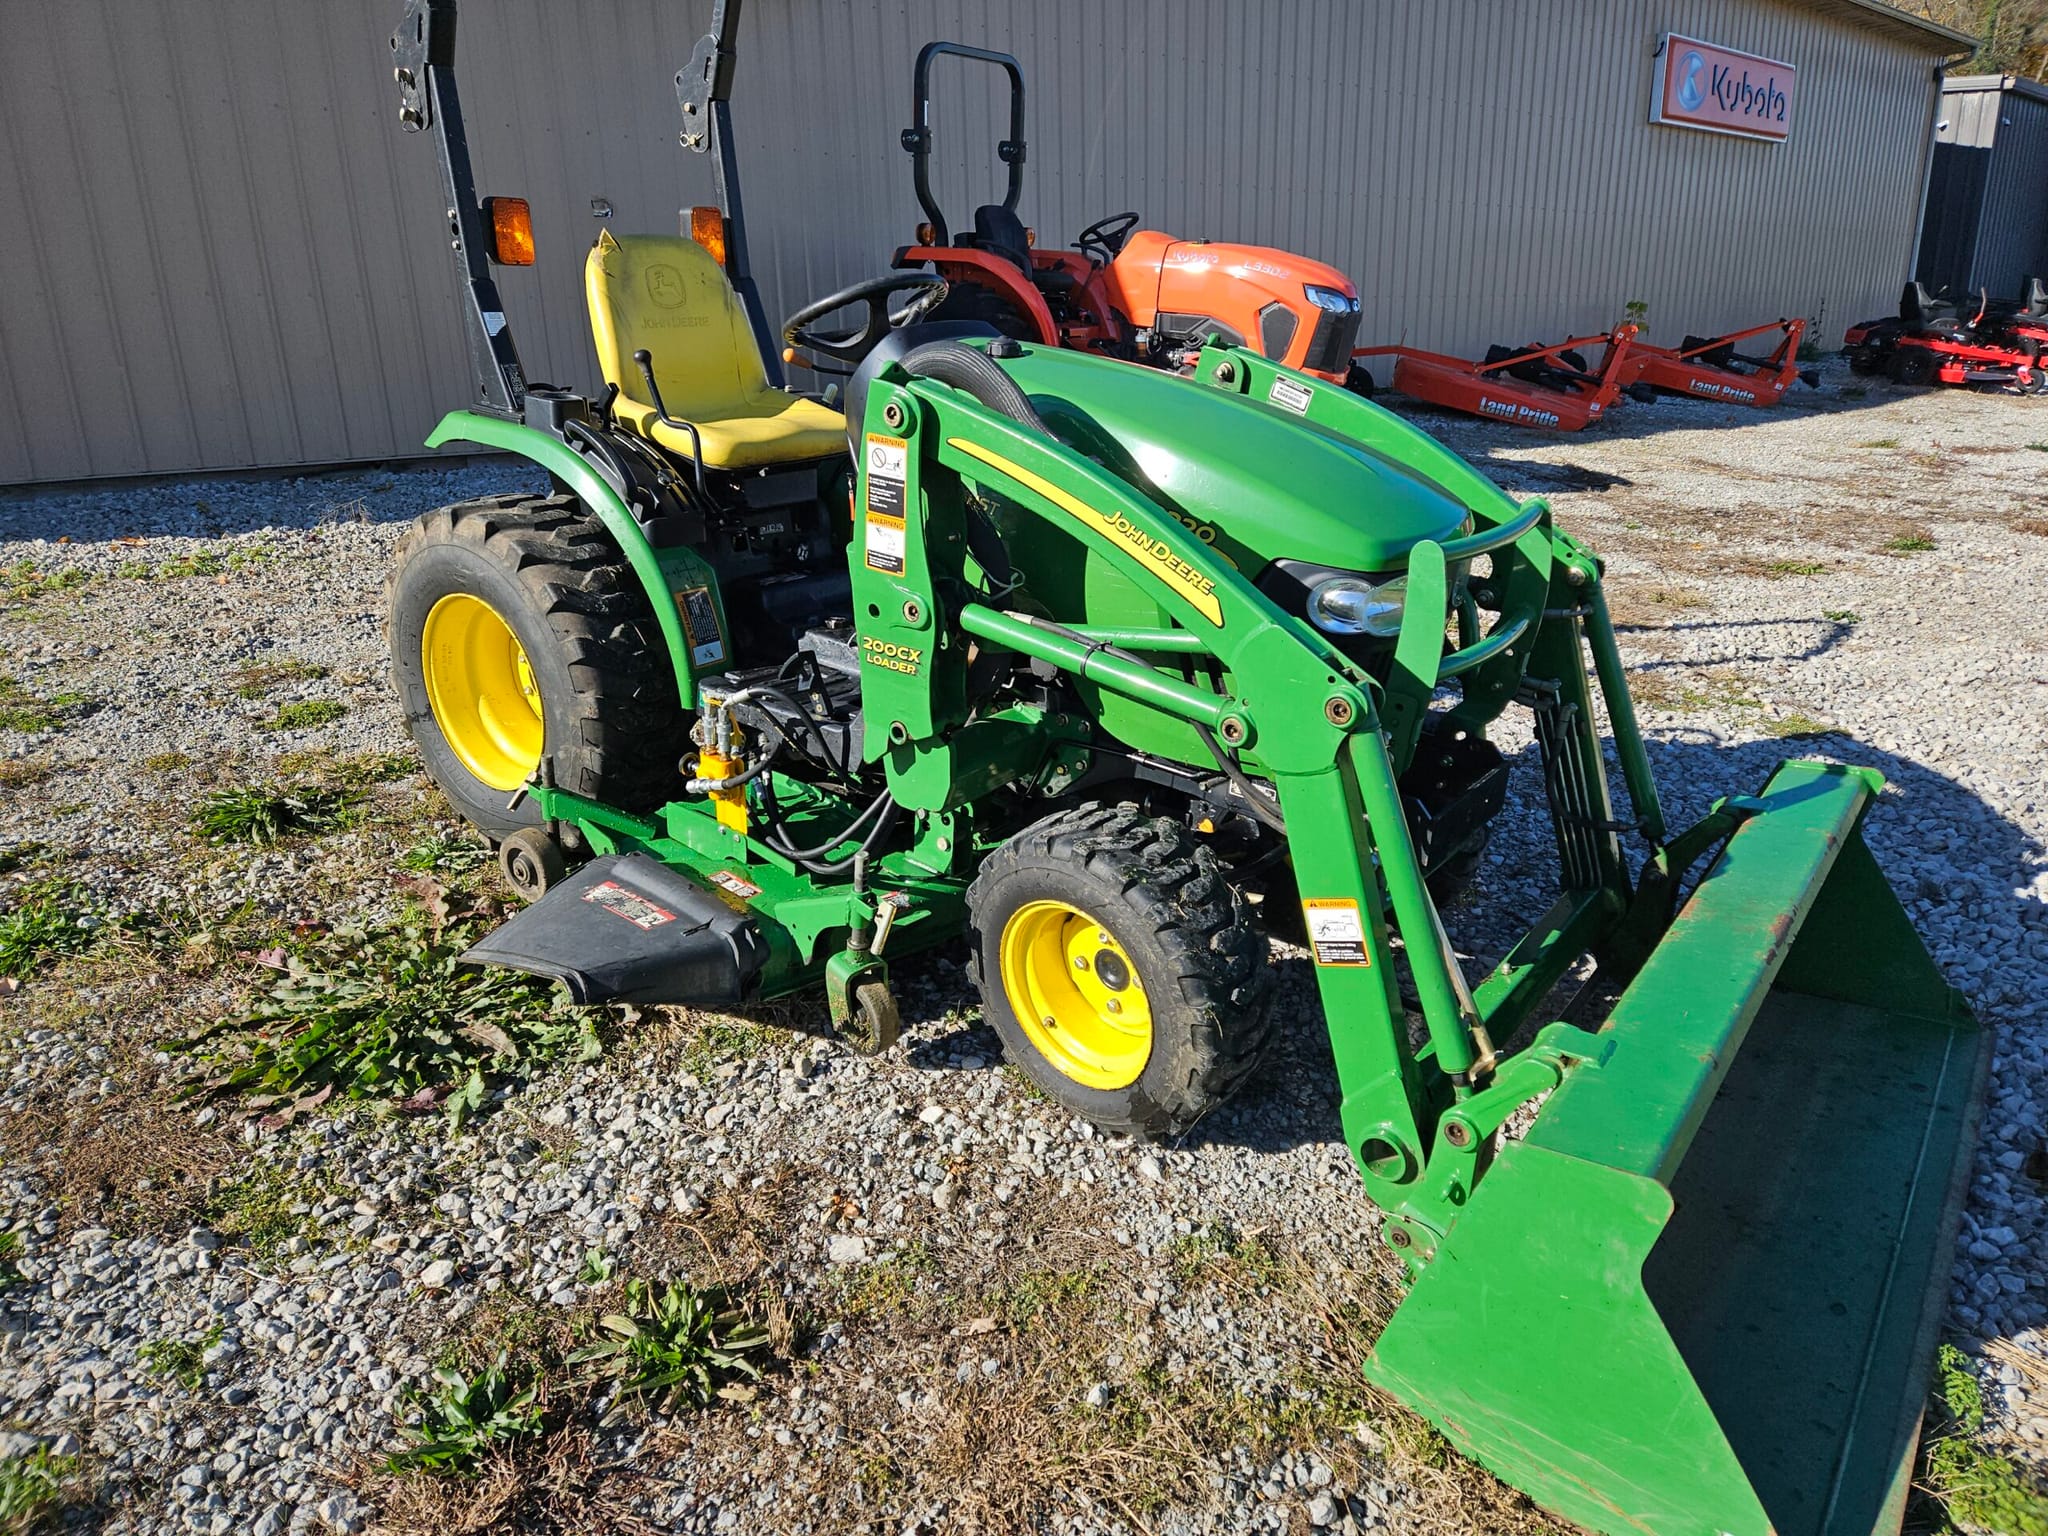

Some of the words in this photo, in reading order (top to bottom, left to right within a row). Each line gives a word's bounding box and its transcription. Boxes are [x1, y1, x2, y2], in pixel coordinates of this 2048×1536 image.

[1711, 64, 1785, 122] Kubota
[1688, 378, 1721, 396] Land
[1721, 385, 1755, 403] Pride
[1479, 396, 1517, 420] Land
[1517, 405, 1560, 428] Pride
[874, 437, 905, 448] WARNING
[872, 519, 904, 530] WARNING
[1103, 511, 1154, 551] JOHN
[1150, 540, 1216, 596] DEERE
[863, 636, 922, 664] 200CX
[866, 652, 916, 675] LOADER
